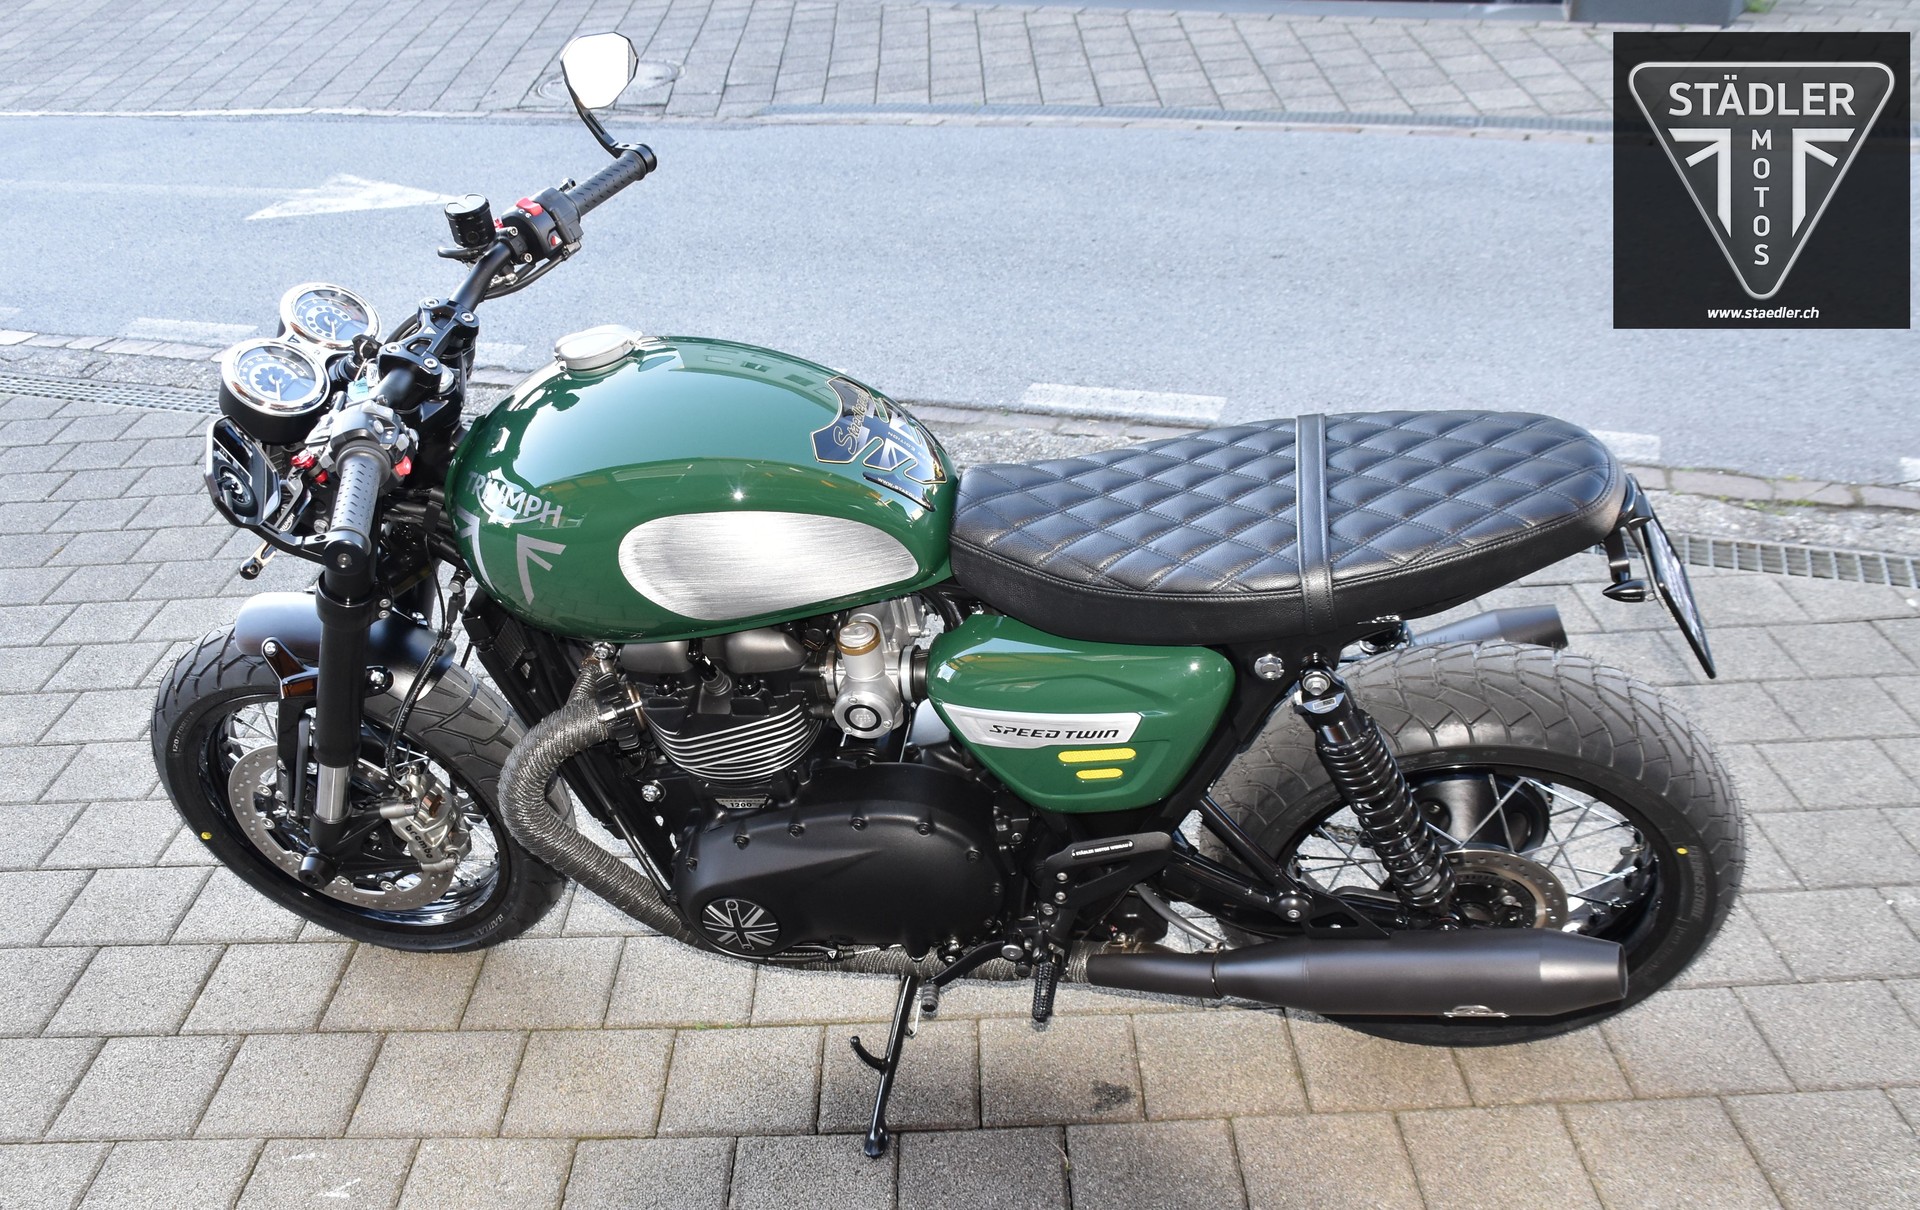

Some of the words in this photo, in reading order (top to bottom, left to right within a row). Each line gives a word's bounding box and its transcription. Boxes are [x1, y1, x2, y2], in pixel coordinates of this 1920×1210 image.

[989, 725, 1061, 739] SPEED
[1065, 729, 1119, 739] TWIN
[405, 824, 433, 859] brembo
